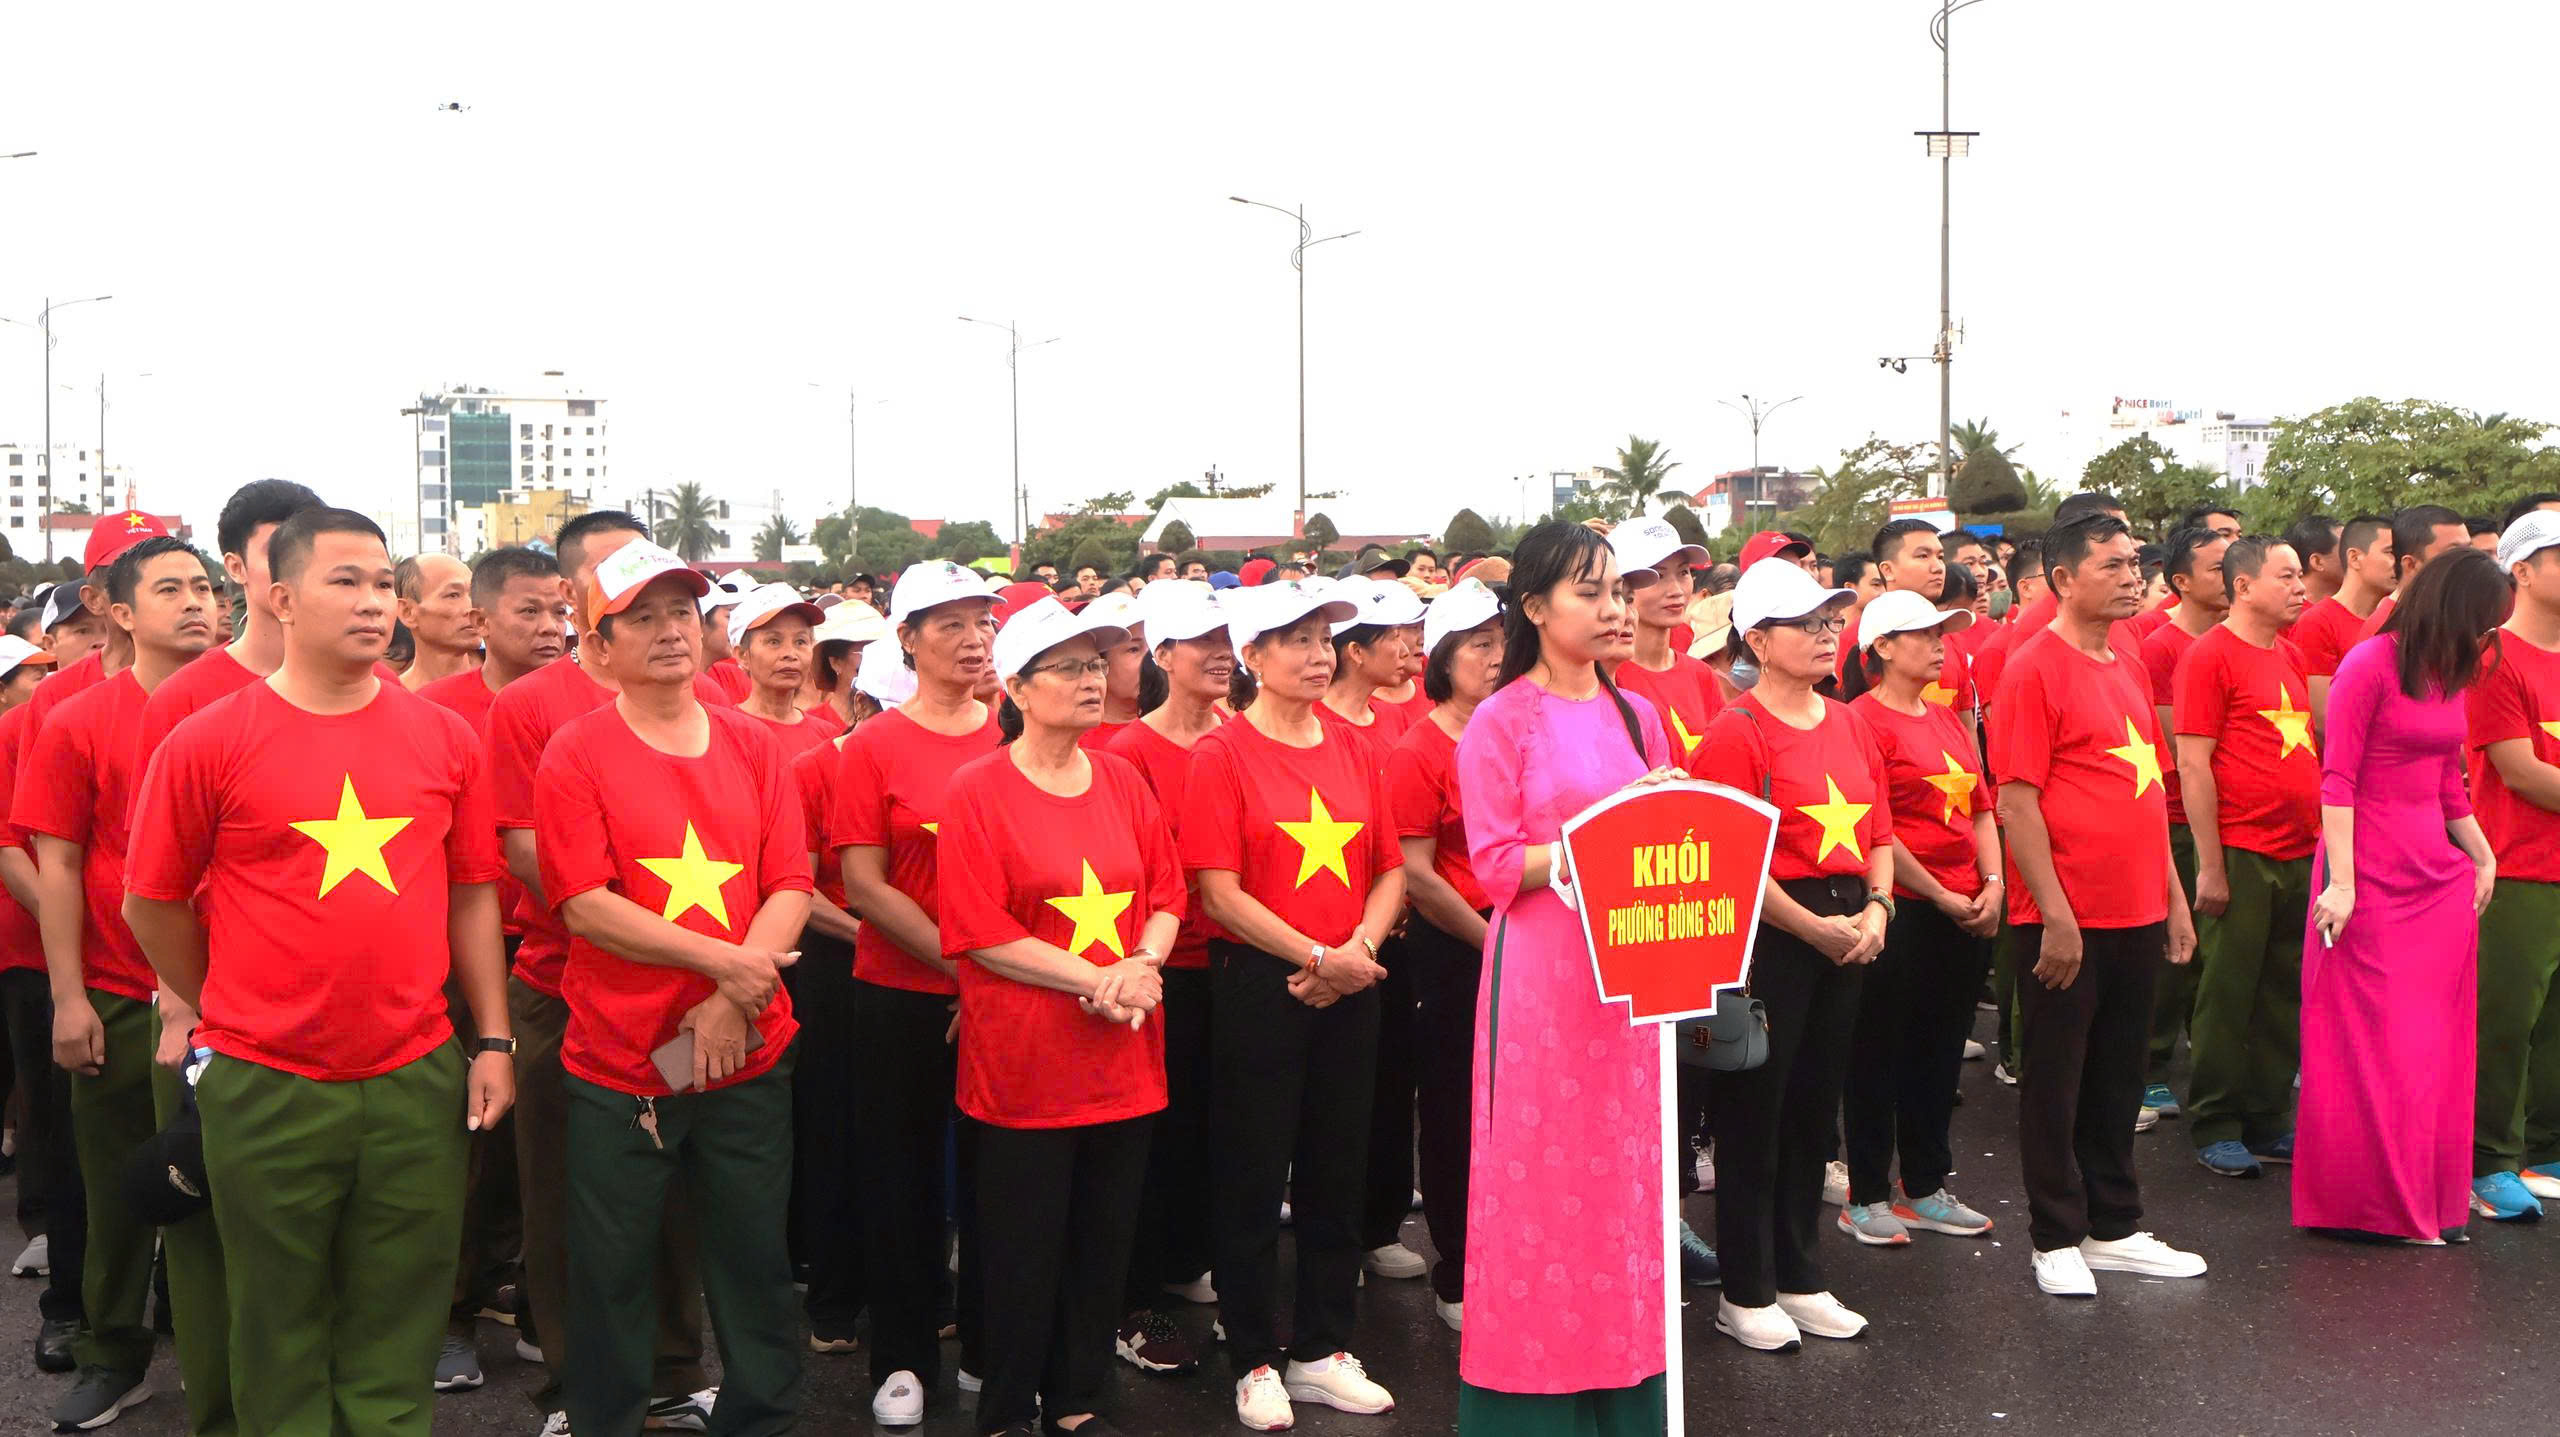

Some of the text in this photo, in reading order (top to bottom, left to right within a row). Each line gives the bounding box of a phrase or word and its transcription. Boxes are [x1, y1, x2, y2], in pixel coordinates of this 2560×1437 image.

[2125, 399, 2148, 408] NICE
[1633, 828, 1710, 888] KHỐI
[1608, 889, 1735, 947] PHƯỜNG ĐỒNG SƠN
